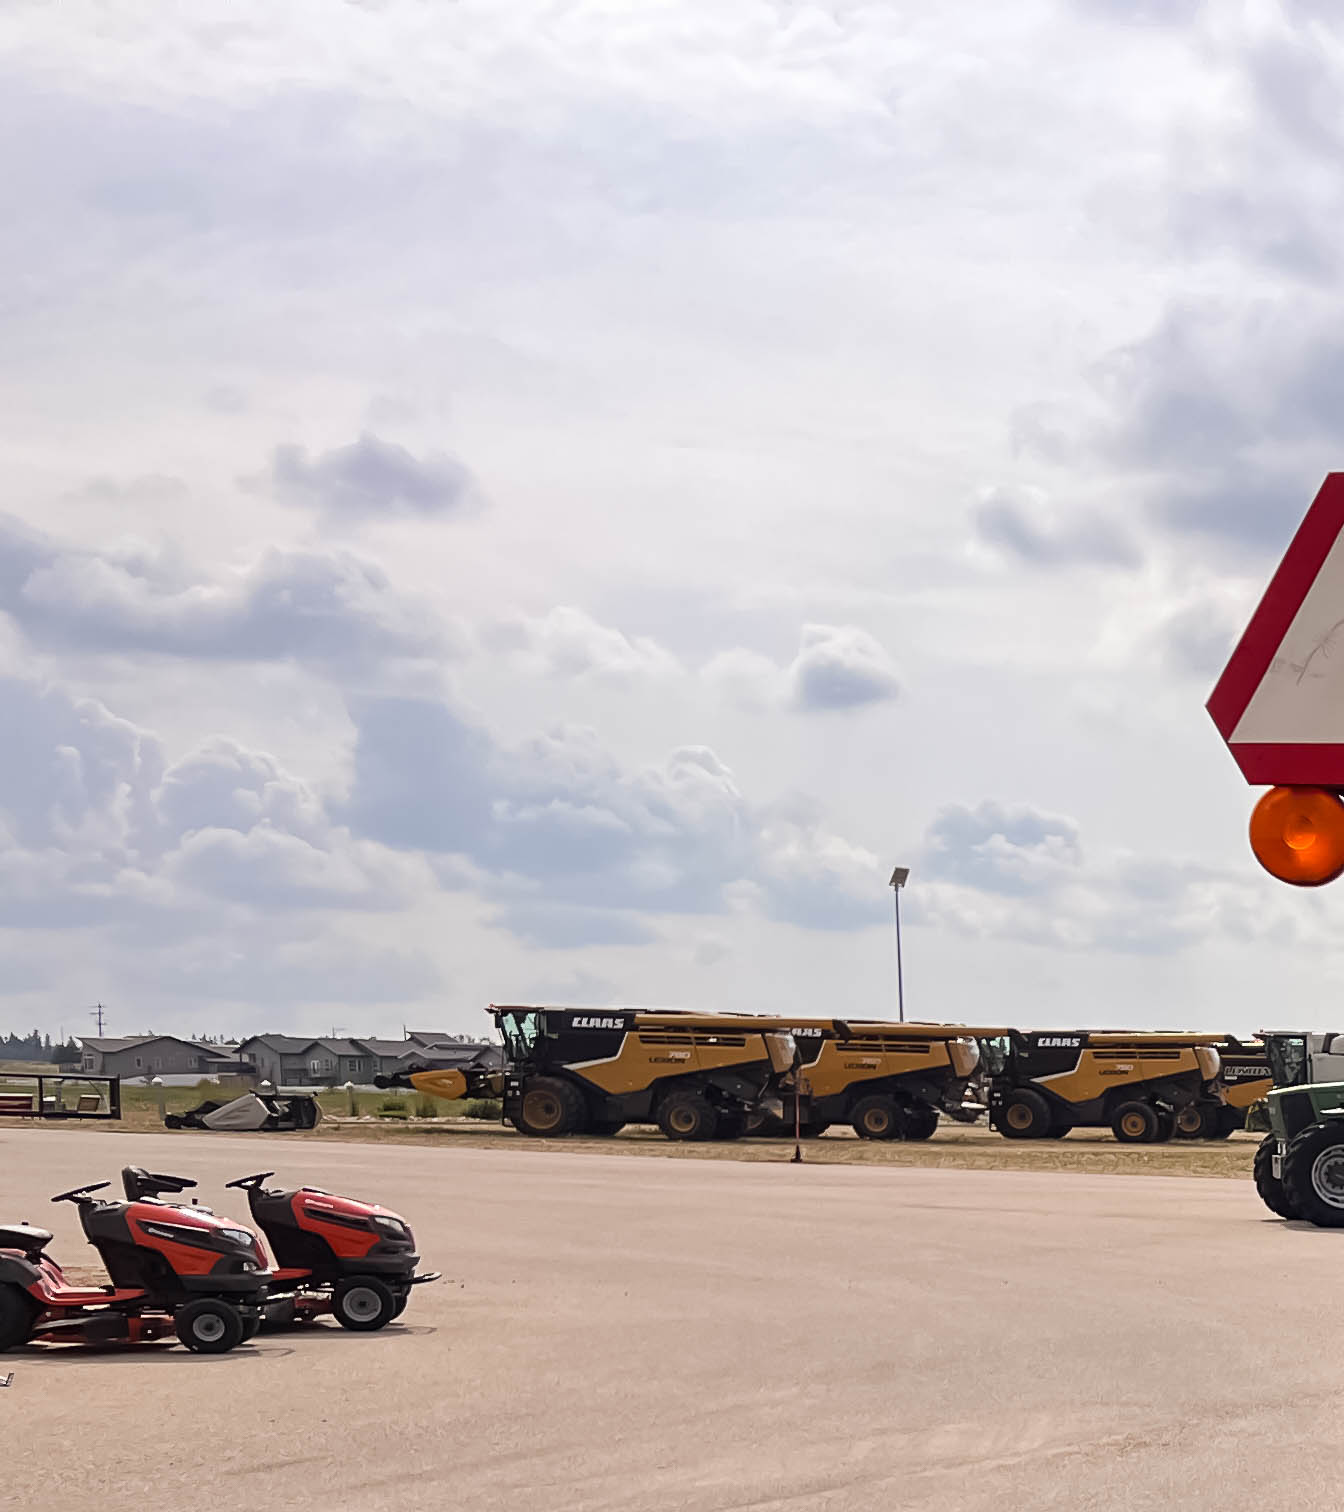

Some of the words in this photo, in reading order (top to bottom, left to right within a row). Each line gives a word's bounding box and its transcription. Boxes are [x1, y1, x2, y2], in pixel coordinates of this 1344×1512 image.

[572, 1017, 625, 1029] CLAAS
[792, 1028, 822, 1037] AAS
[1037, 1038, 1081, 1047] CLAAS
